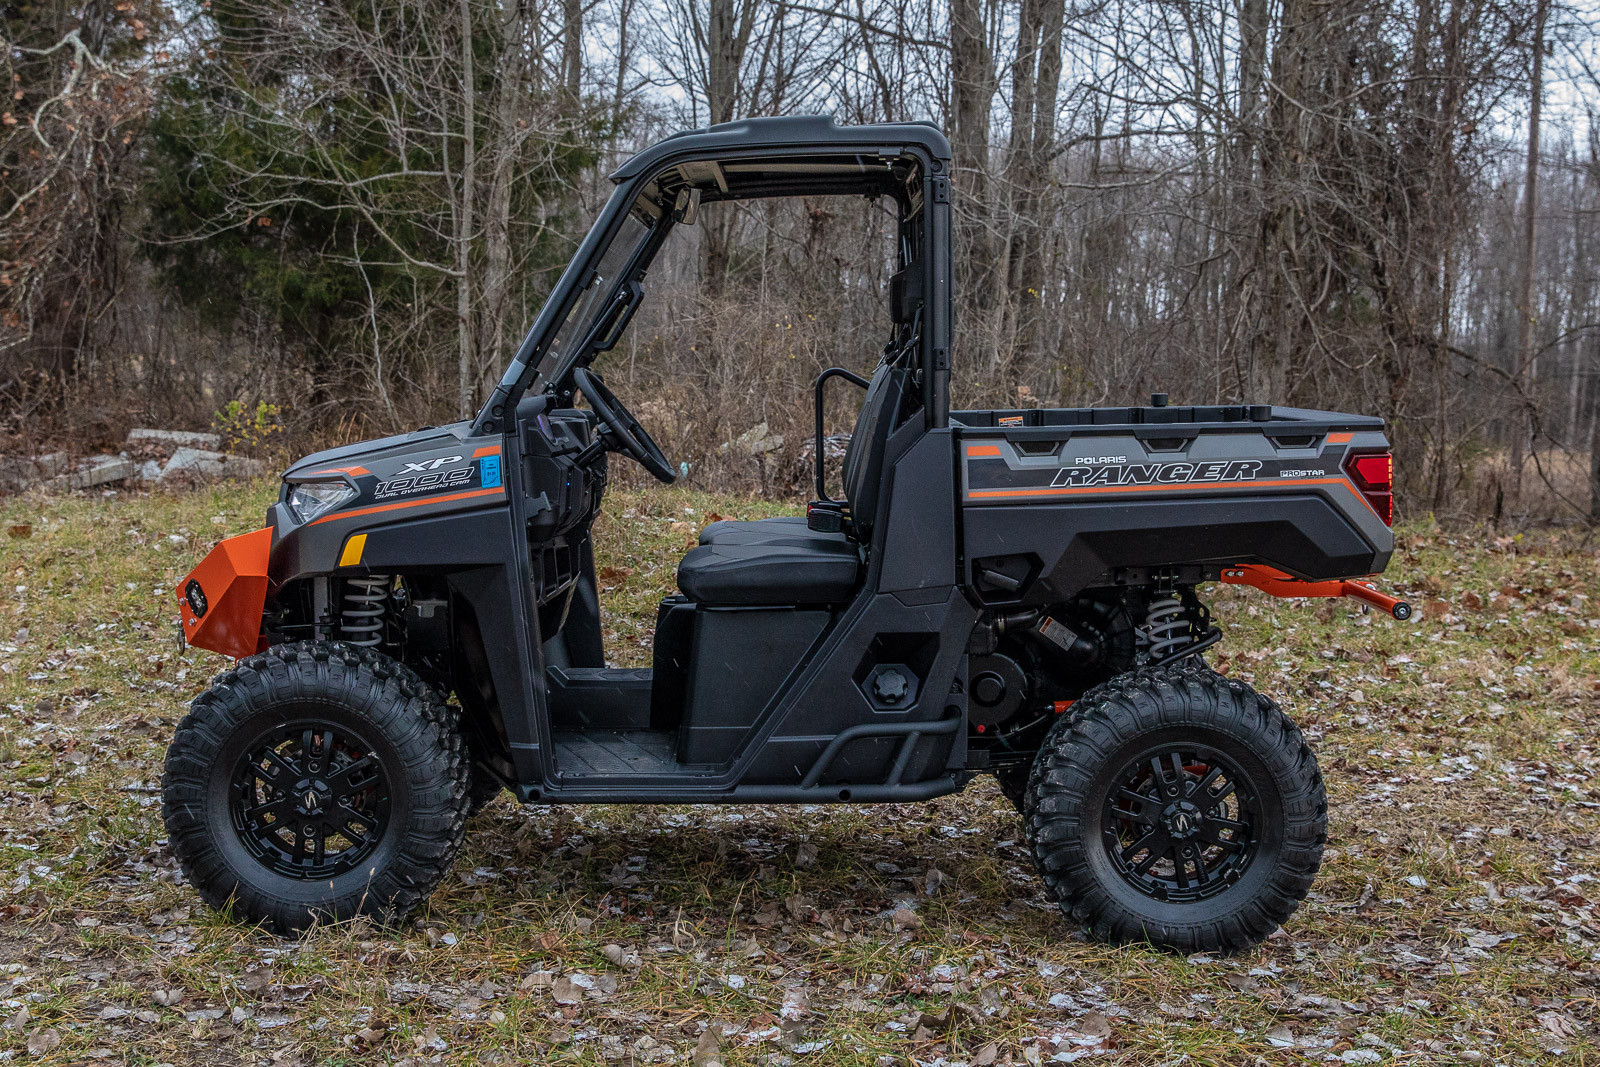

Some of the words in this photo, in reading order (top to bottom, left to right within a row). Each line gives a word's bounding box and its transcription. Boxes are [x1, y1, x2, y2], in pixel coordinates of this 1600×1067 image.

[392, 455, 464, 476] XP
[1075, 455, 1127, 465] POLARIS
[374, 466, 475, 495] 1000
[1049, 460, 1263, 488] RANGER
[375, 491, 399, 500] DUAL
[401, 483, 449, 495] OVERHEAD
[449, 479, 470, 487] CAM
